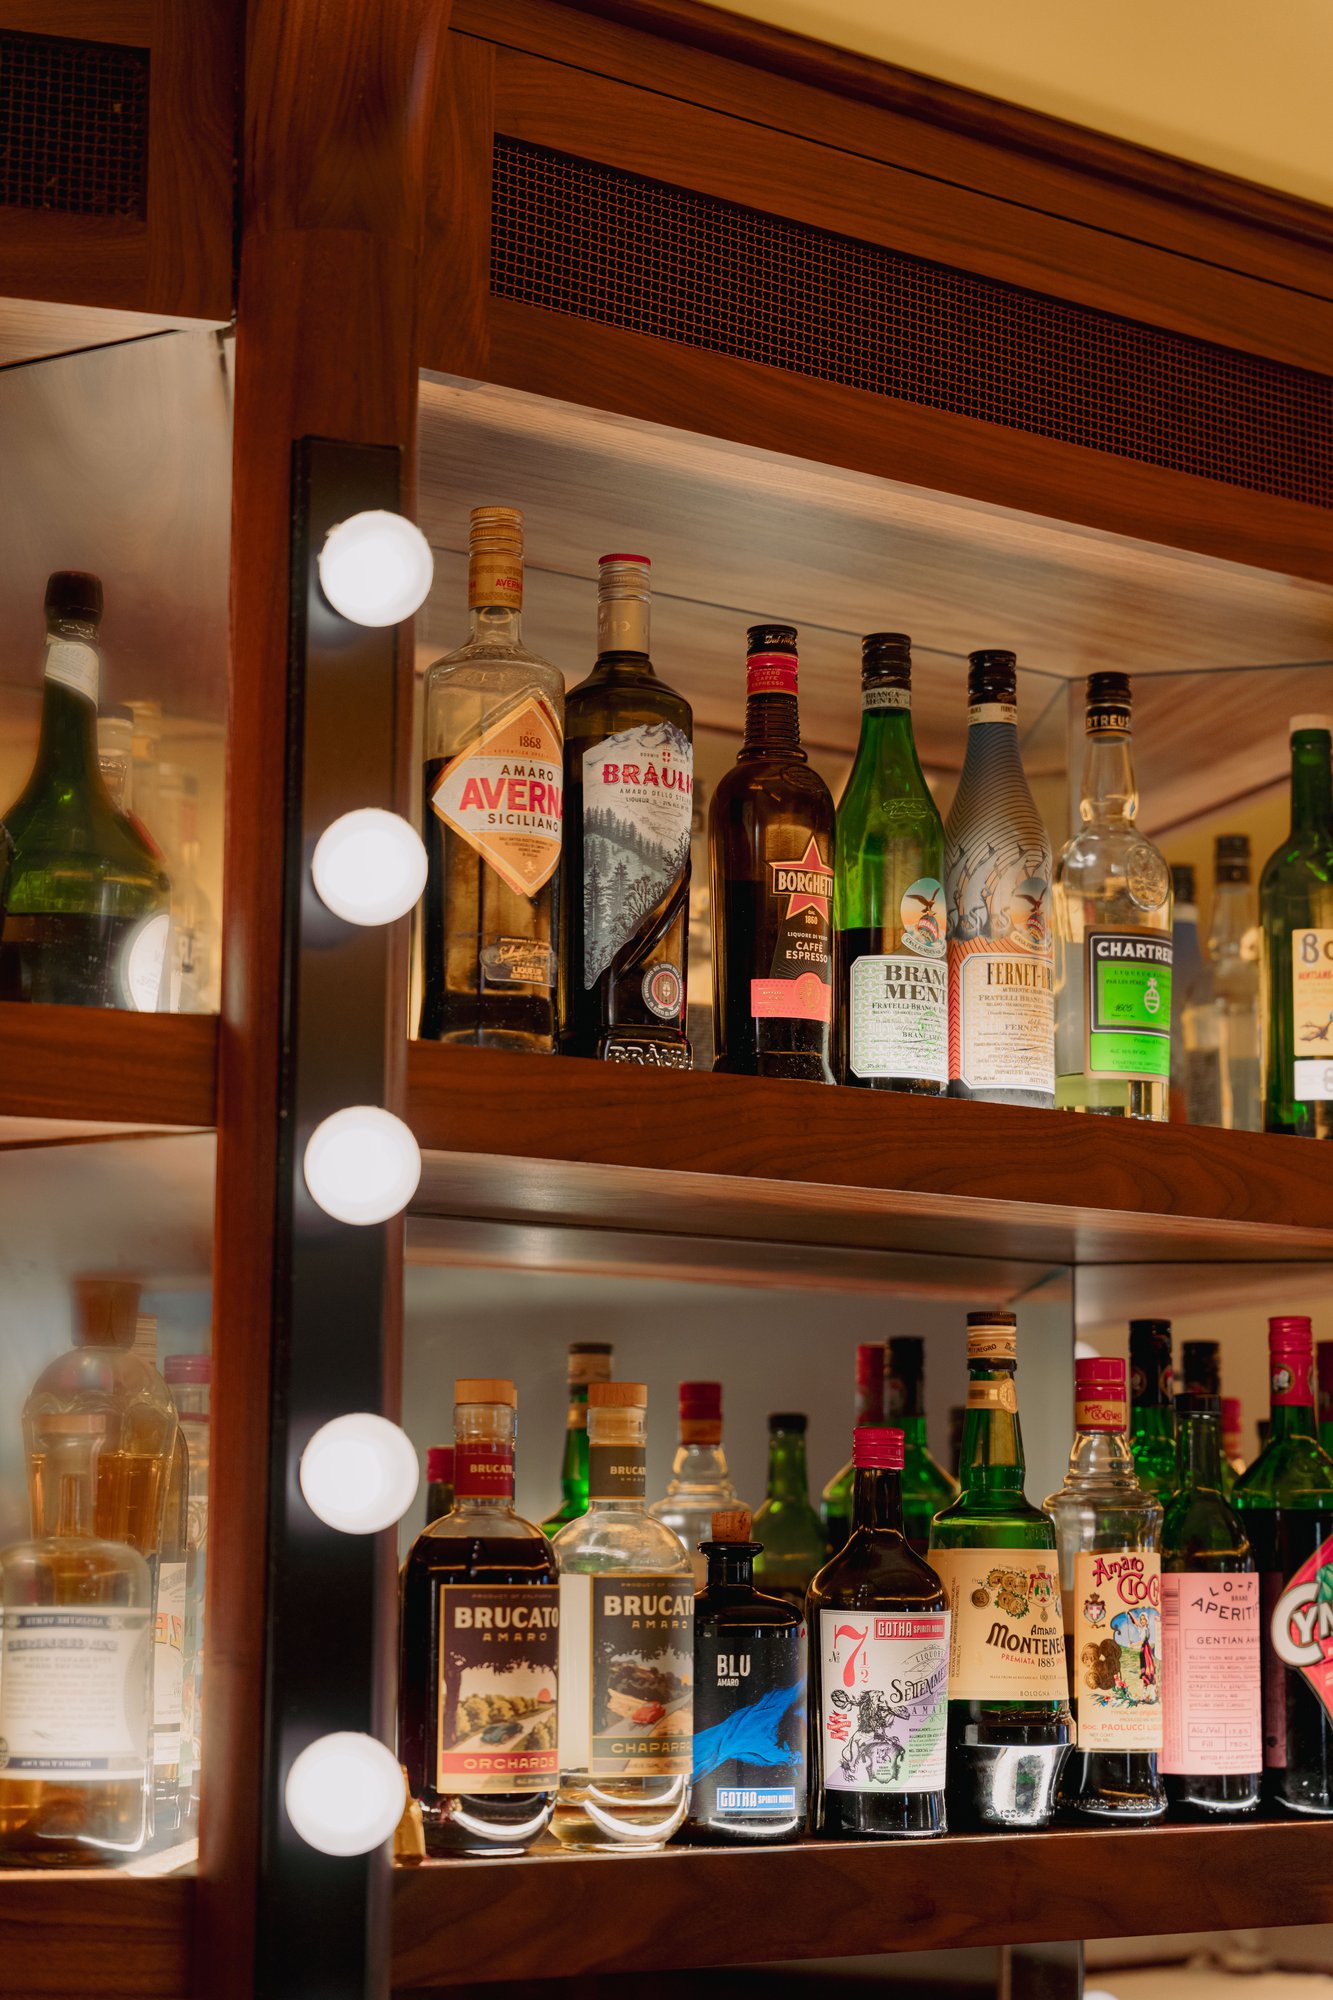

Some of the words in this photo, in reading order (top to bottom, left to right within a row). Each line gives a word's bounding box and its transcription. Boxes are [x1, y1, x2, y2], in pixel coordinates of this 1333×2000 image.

[520, 736, 541, 749] 1868
[501, 765, 554, 781] AMARO
[459, 778, 562, 820] AVERN
[488, 813, 558, 832] SICILIANO
[796, 941, 823, 952] CAFFÈ
[786, 950, 828, 963] ESPRESSO
[1092, 1555, 1145, 1587] Amaro
[454, 1606, 559, 1629] BRUCATO
[632, 1620, 688, 1629] AMARO
[878, 1621, 912, 1637] GOTHA
[482, 1632, 547, 1642] AMARO
[1197, 1636, 1243, 1645] GENTIAN
[716, 1654, 751, 1677] BLU
[1001, 1653, 1035, 1665] PREMIATA
[1038, 1657, 1055, 1667] 1885
[717, 1678, 740, 1687] AMARO
[1101, 1723, 1145, 1731] PAOLUCCI
[463, 1757, 555, 1770] ORCHARDS
[721, 1791, 757, 1807] GOTHA
